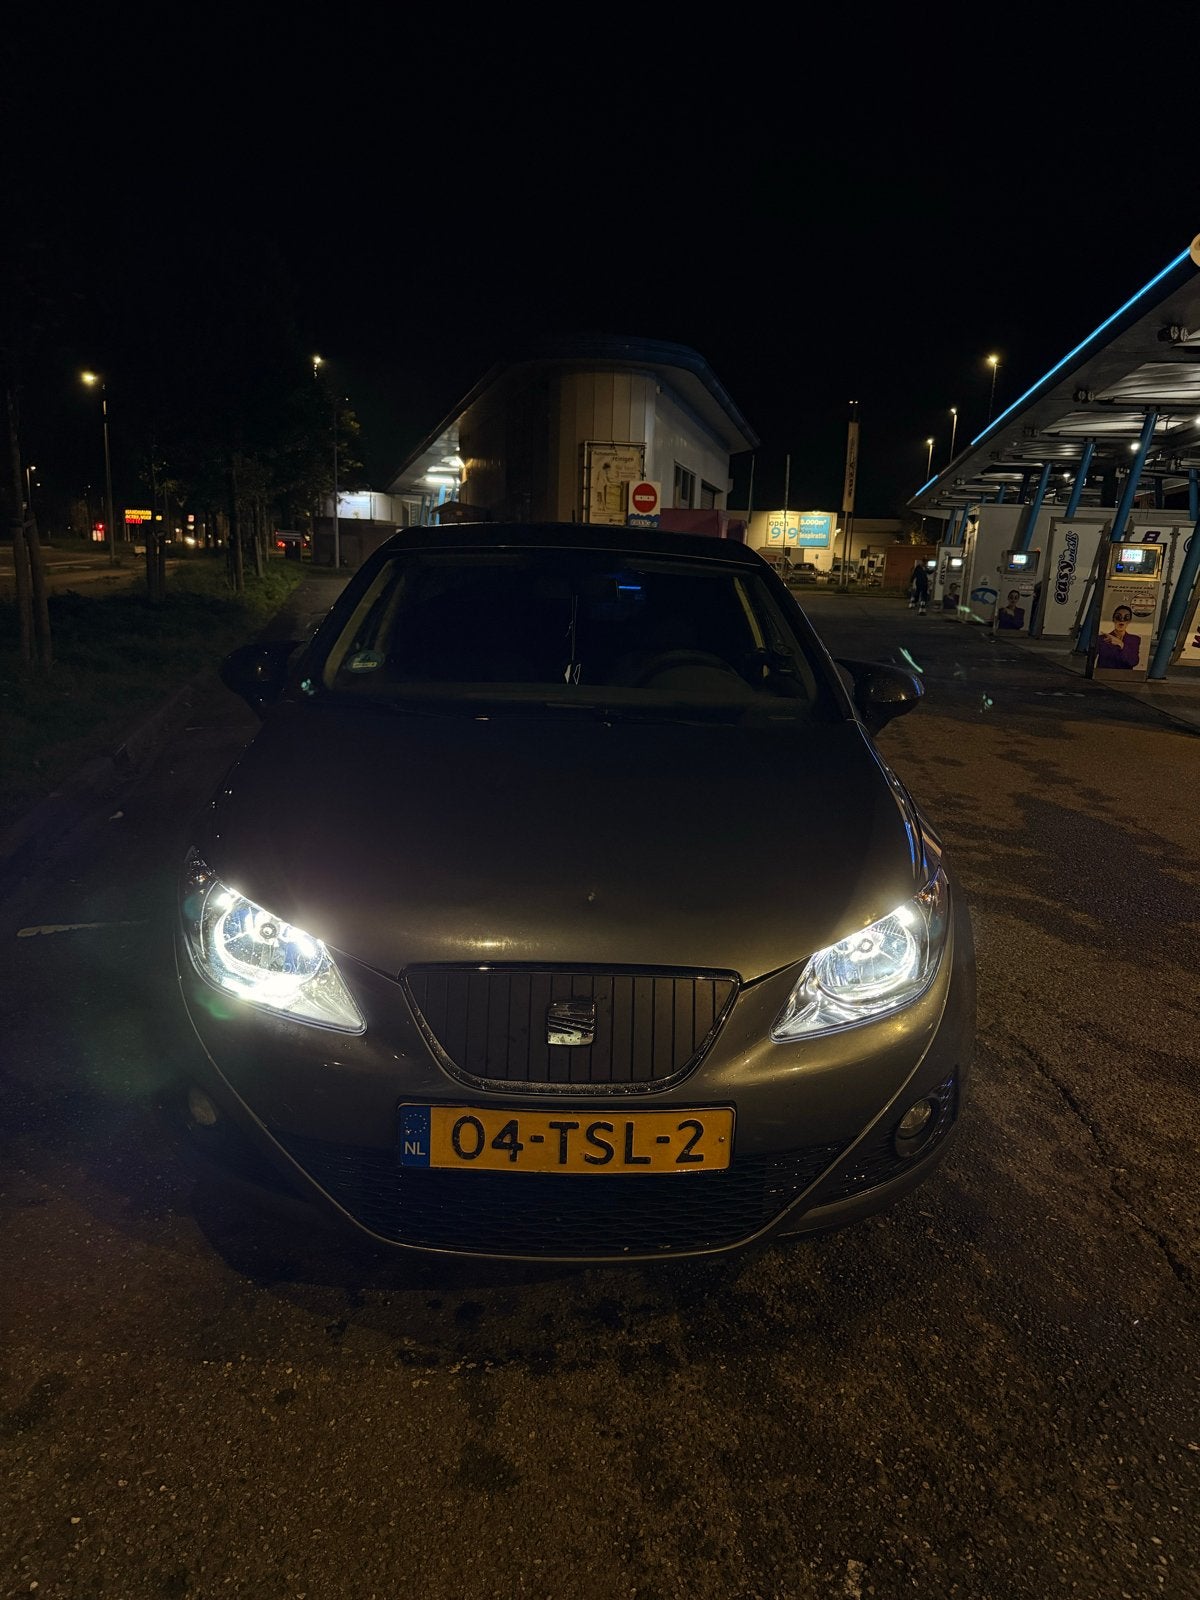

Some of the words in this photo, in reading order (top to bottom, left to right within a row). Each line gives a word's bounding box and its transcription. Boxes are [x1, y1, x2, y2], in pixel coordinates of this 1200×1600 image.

[1055, 559, 1075, 604] easy
[404, 1141, 426, 1156] NL
[453, 1115, 704, 1164] 04-TSL-2
